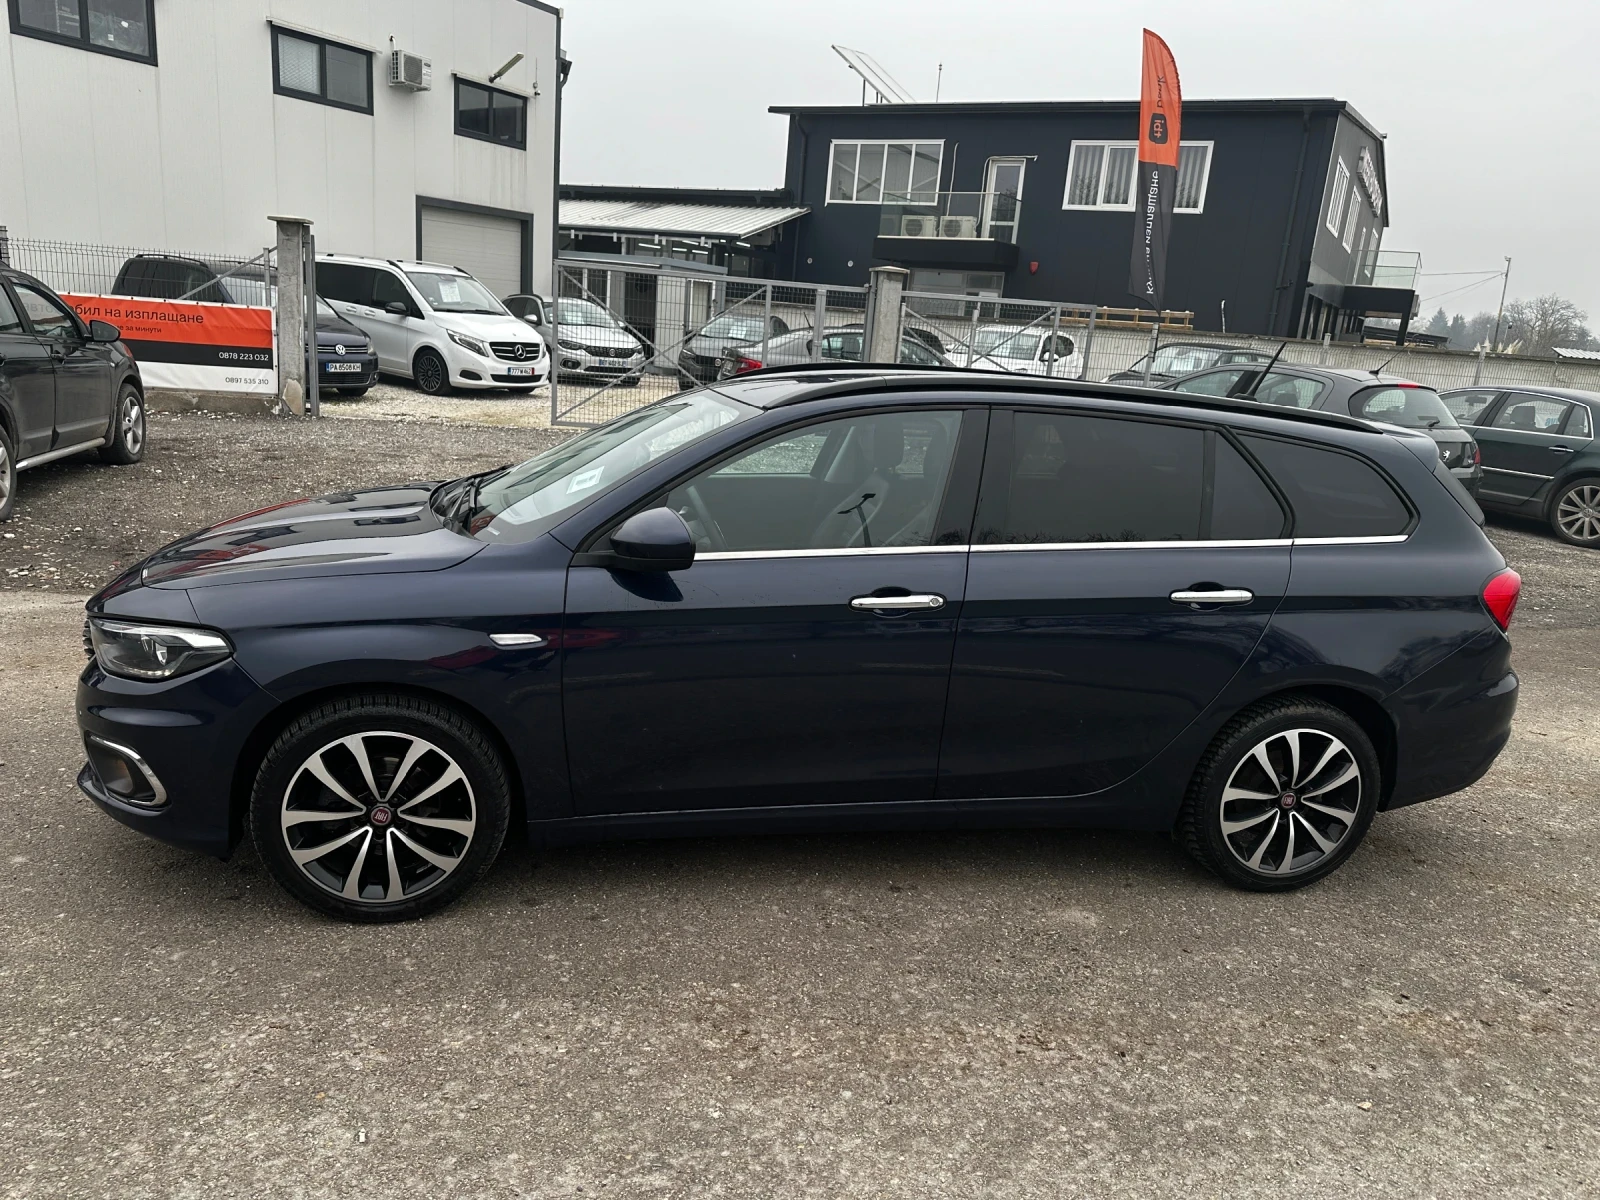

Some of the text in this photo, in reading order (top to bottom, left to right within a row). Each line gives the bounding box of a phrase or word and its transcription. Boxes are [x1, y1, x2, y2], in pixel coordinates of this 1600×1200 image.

[104, 308, 121, 318] на
[125, 309, 204, 324] изплащане
[135, 326, 162, 334] минути
[218, 351, 269, 361] 0878 223 032
[225, 376, 242, 384] 0897
[243, 377, 257, 385] 535
